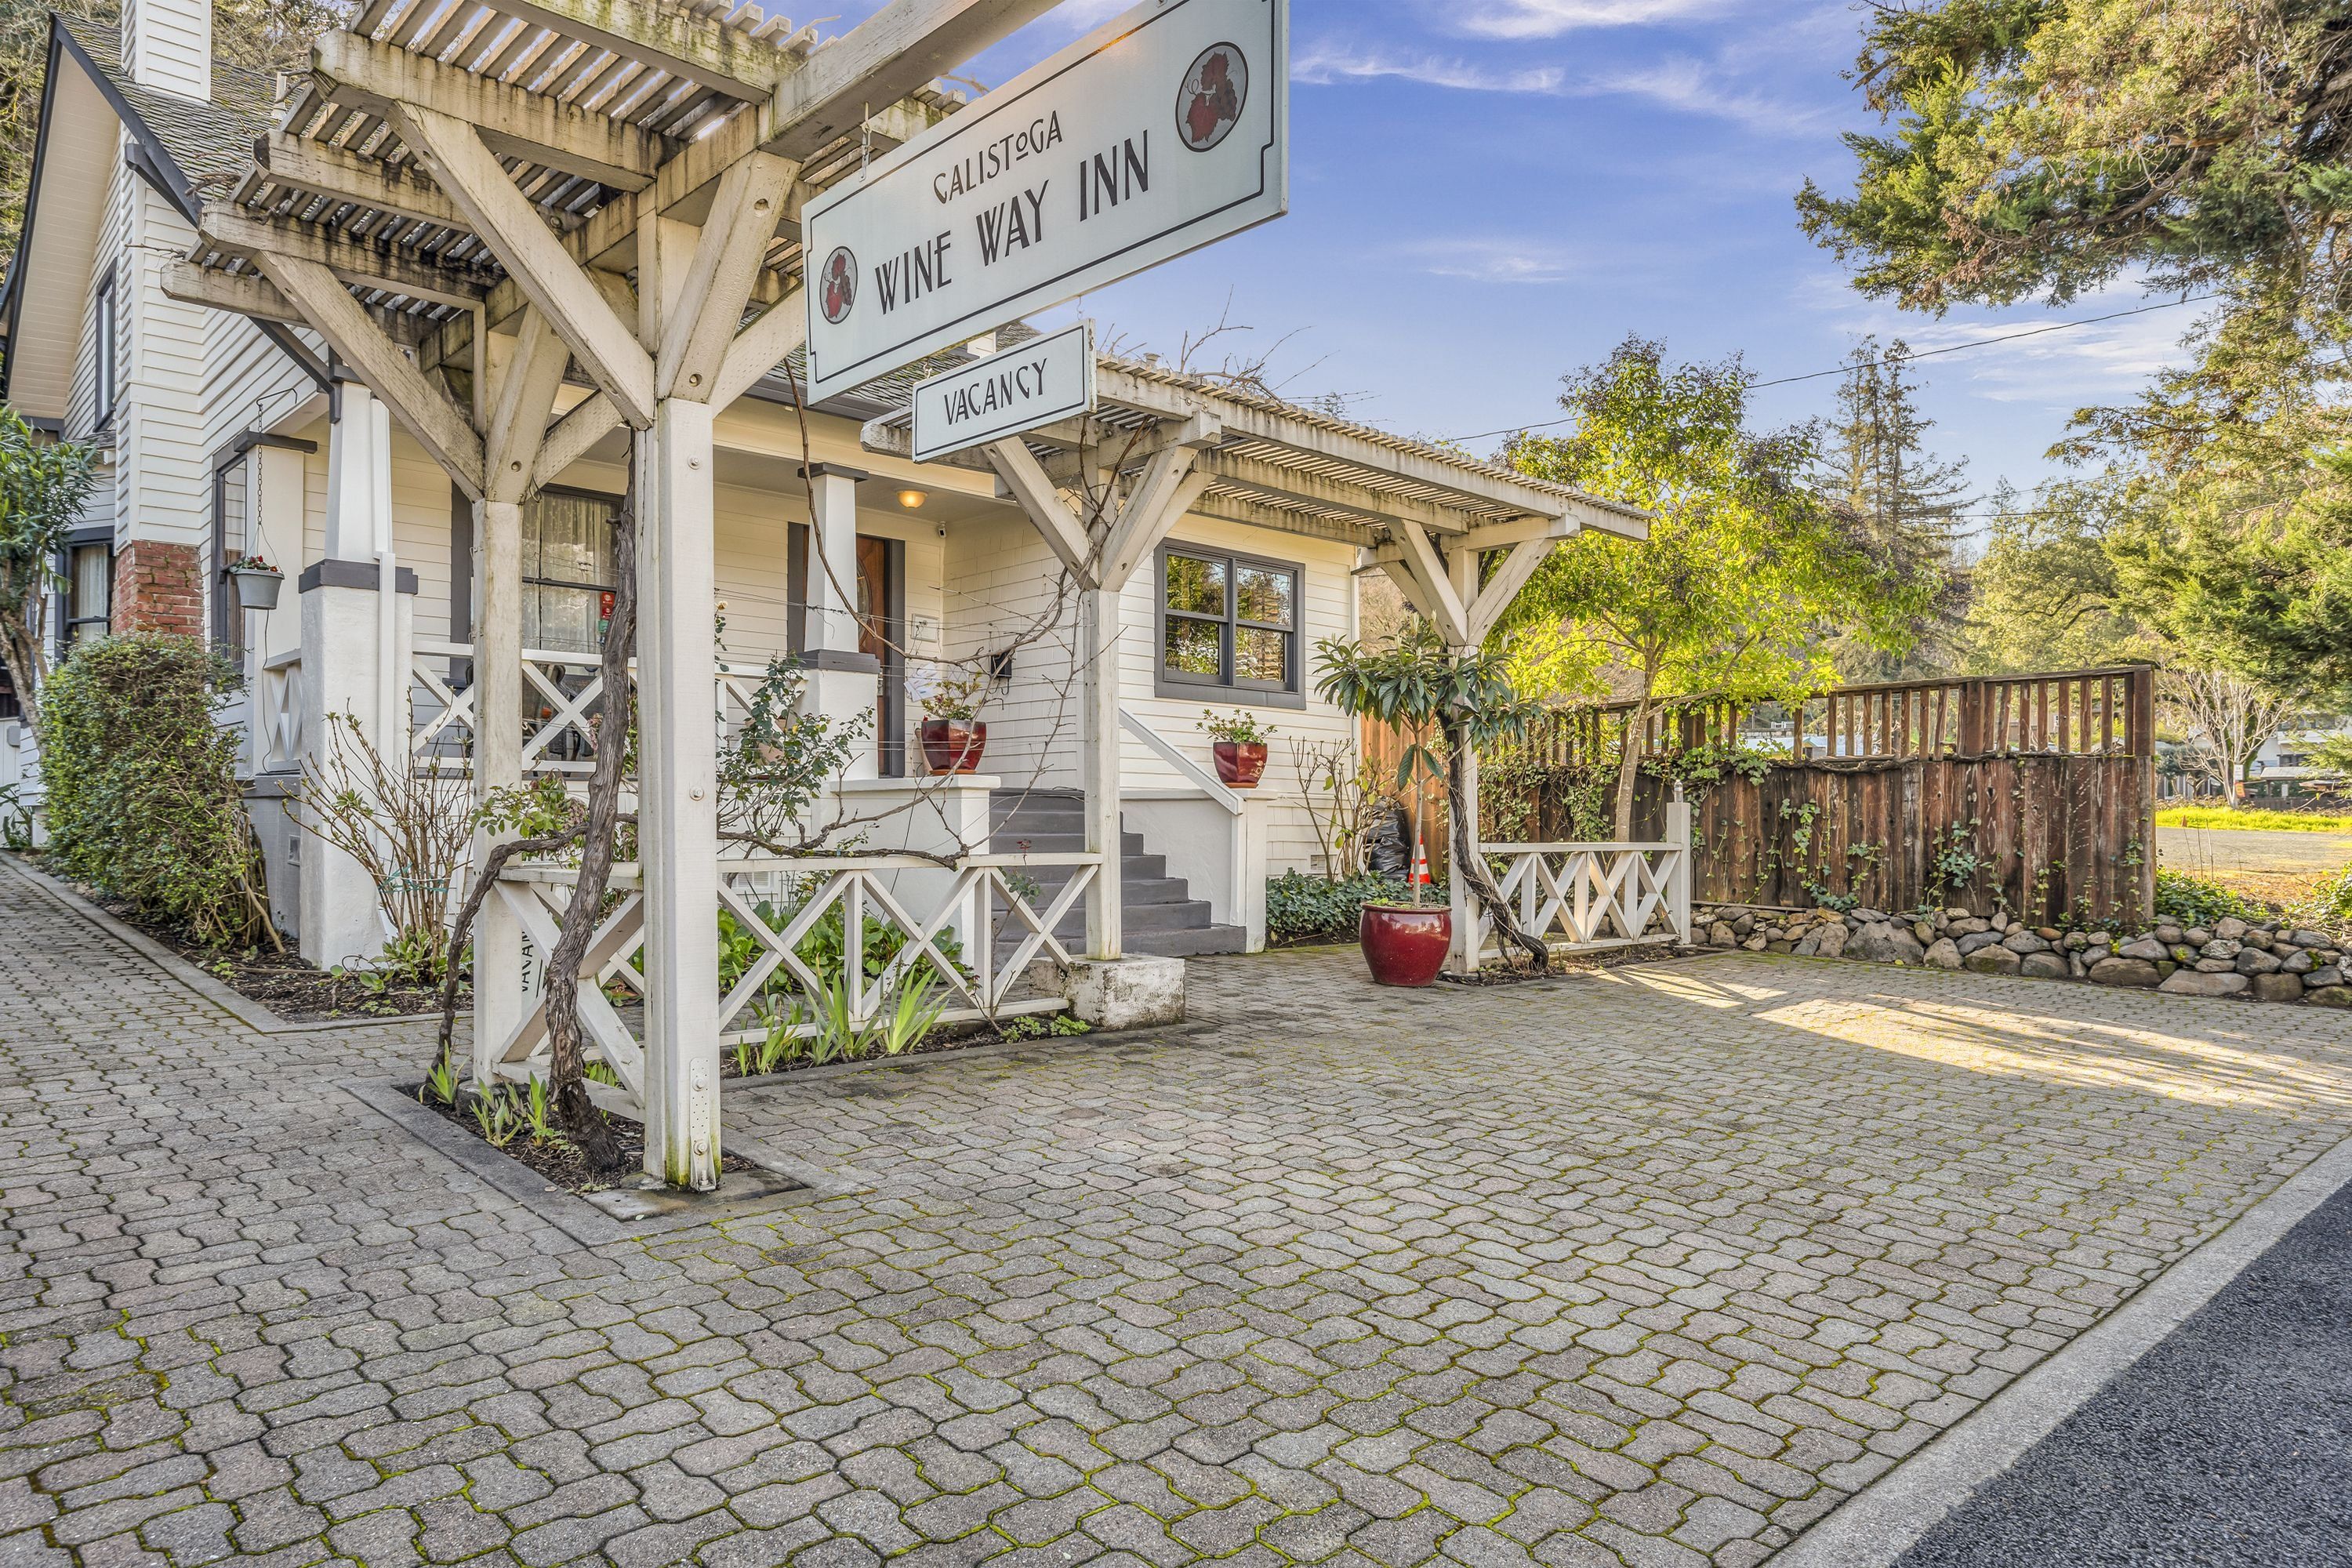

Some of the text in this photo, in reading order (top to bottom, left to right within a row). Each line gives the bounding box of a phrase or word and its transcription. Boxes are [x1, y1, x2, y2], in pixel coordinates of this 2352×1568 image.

[933, 110, 1062, 204] CALISTOGA
[874, 129, 1149, 314] WINE WAY INN
[944, 358, 1047, 425] VACANCY
